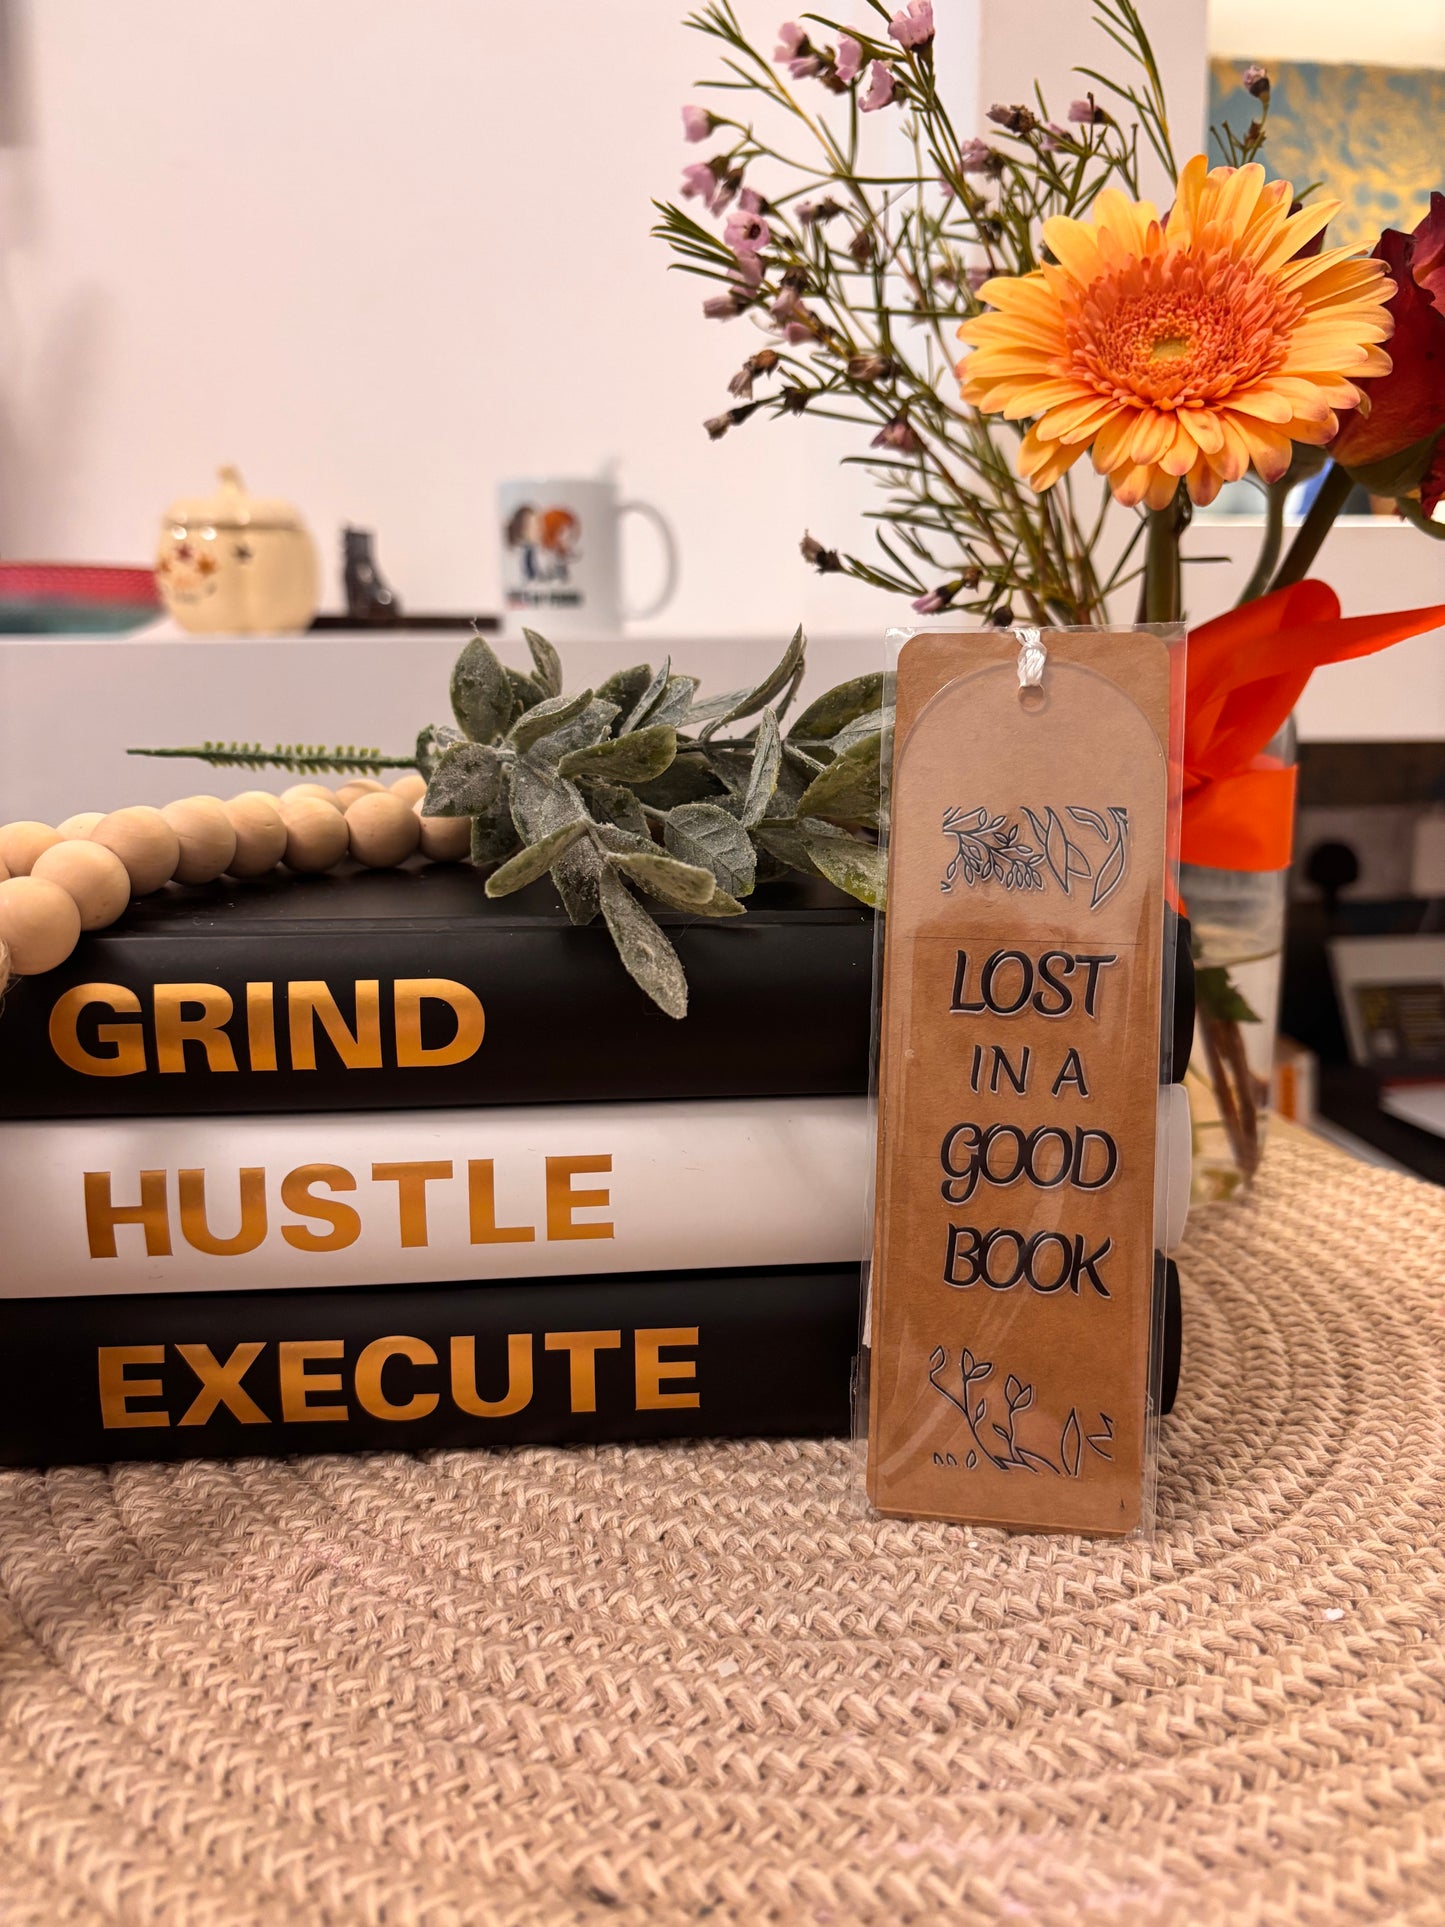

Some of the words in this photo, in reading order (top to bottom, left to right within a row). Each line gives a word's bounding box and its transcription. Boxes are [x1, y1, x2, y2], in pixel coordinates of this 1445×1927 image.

[950, 949, 1118, 1018] LOST
[49, 979, 486, 1077] GRIND
[970, 1044, 1031, 1096] IN
[1051, 1047, 1089, 1097] A
[83, 1154, 616, 1260] HUSTLE
[943, 1222, 1112, 1298] BOOK
[98, 1327, 701, 1430] EXECUTE
